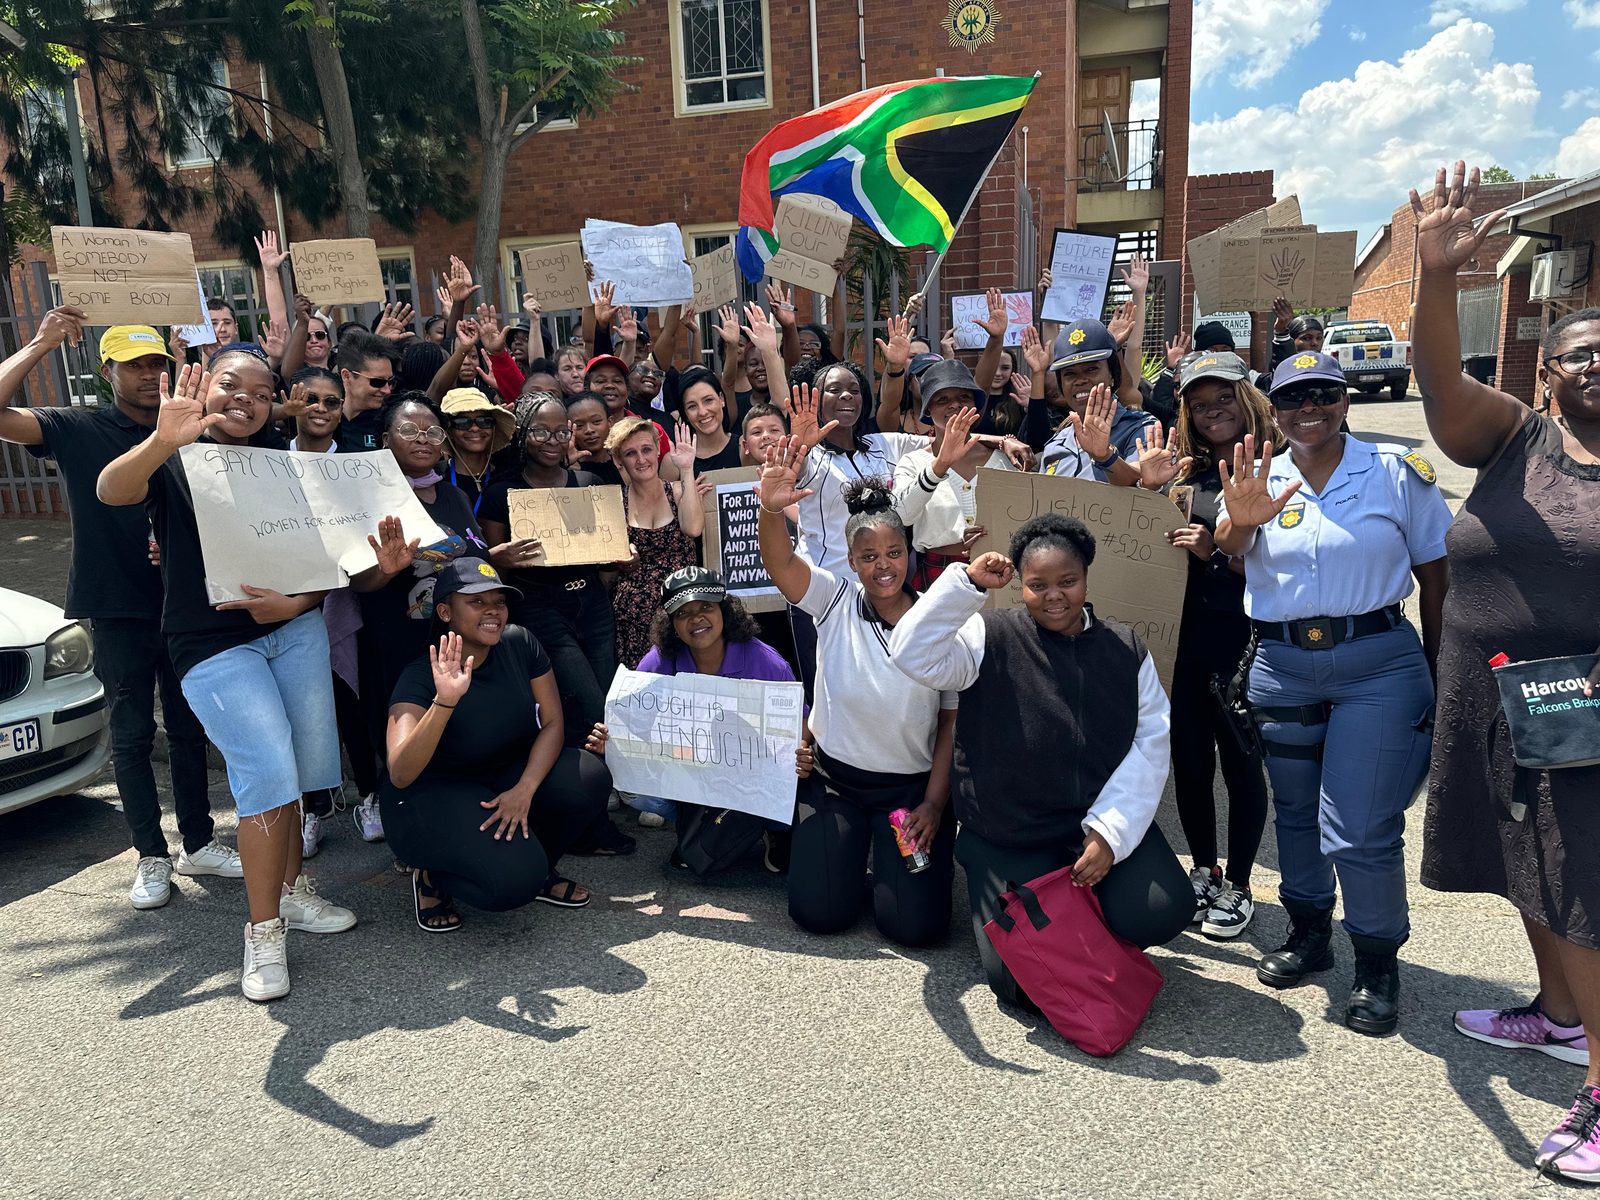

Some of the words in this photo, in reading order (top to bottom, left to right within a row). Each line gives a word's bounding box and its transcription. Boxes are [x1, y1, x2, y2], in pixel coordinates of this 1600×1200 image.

[782, 204, 848, 245] KILLING
[61, 232, 74, 247] A
[82, 232, 130, 247] Woman
[1223, 240, 1250, 248] UNITED
[63, 250, 148, 267] SOMEBODY
[293, 247, 355, 265] Womens
[1055, 242, 1112, 259] FUTURE
[525, 251, 570, 271] Enough
[1053, 261, 1106, 277] FEMALE
[93, 268, 132, 282] NOT
[296, 265, 324, 280] Rights
[329, 264, 345, 273] Are
[298, 281, 331, 294] Human
[333, 276, 369, 294] Rights
[706, 275, 720, 290] TO
[68, 291, 111, 306] SOME
[130, 291, 171, 306] BODY
[535, 285, 580, 301] Enough
[955, 295, 987, 311] STO
[1221, 319, 1249, 329] TRANCE
[205, 449, 259, 478] SAY
[265, 453, 304, 479] NO
[309, 457, 339, 481] TO
[342, 458, 383, 480] GBV
[510, 496, 536, 513] We
[546, 492, 571, 506] Are
[722, 494, 742, 509] FOR
[1006, 478, 1113, 525] Justice
[1128, 493, 1162, 531] For
[1335, 493, 1359, 506] POLICE
[728, 508, 753, 522] WHO
[249, 517, 301, 538] WOMEN
[724, 540, 746, 553] AND
[727, 554, 757, 567] THAT
[1521, 677, 1586, 698] Harcou
[615, 675, 693, 718] ENOUGH
[708, 701, 725, 721] IS
[1528, 701, 1572, 716] Falcons
[1572, 697, 1600, 709] Brakp
[12, 724, 36, 753] GP
